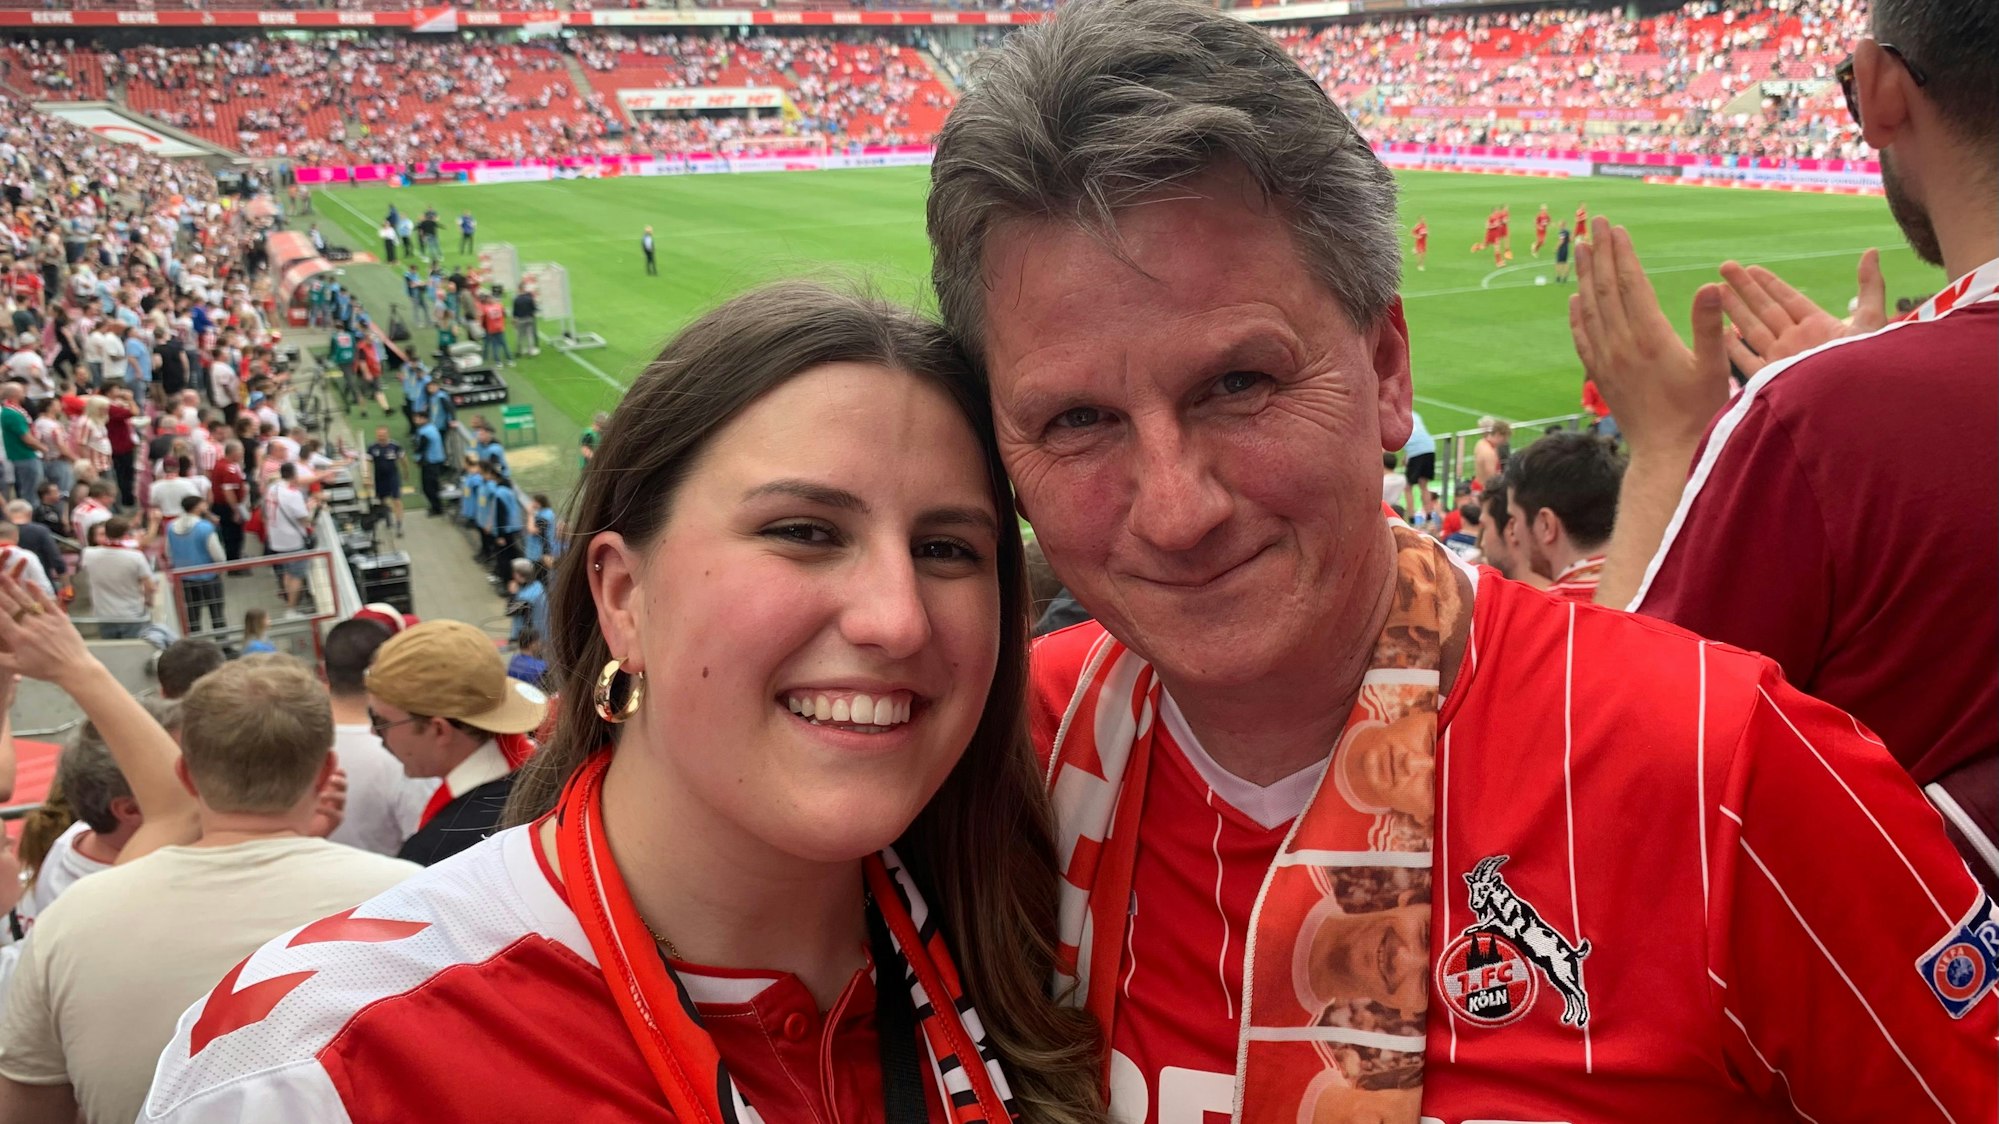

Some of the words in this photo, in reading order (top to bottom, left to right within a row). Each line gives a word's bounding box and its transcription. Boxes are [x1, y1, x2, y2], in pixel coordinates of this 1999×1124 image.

[32, 11, 74, 24] REWE
[117, 11, 160, 24] REWE
[258, 11, 298, 24] REWE
[337, 11, 376, 24] REWE
[466, 11, 501, 24] REWE
[1938, 946, 1965, 972] UEFA
[1468, 988, 1508, 1013] KÖLN
